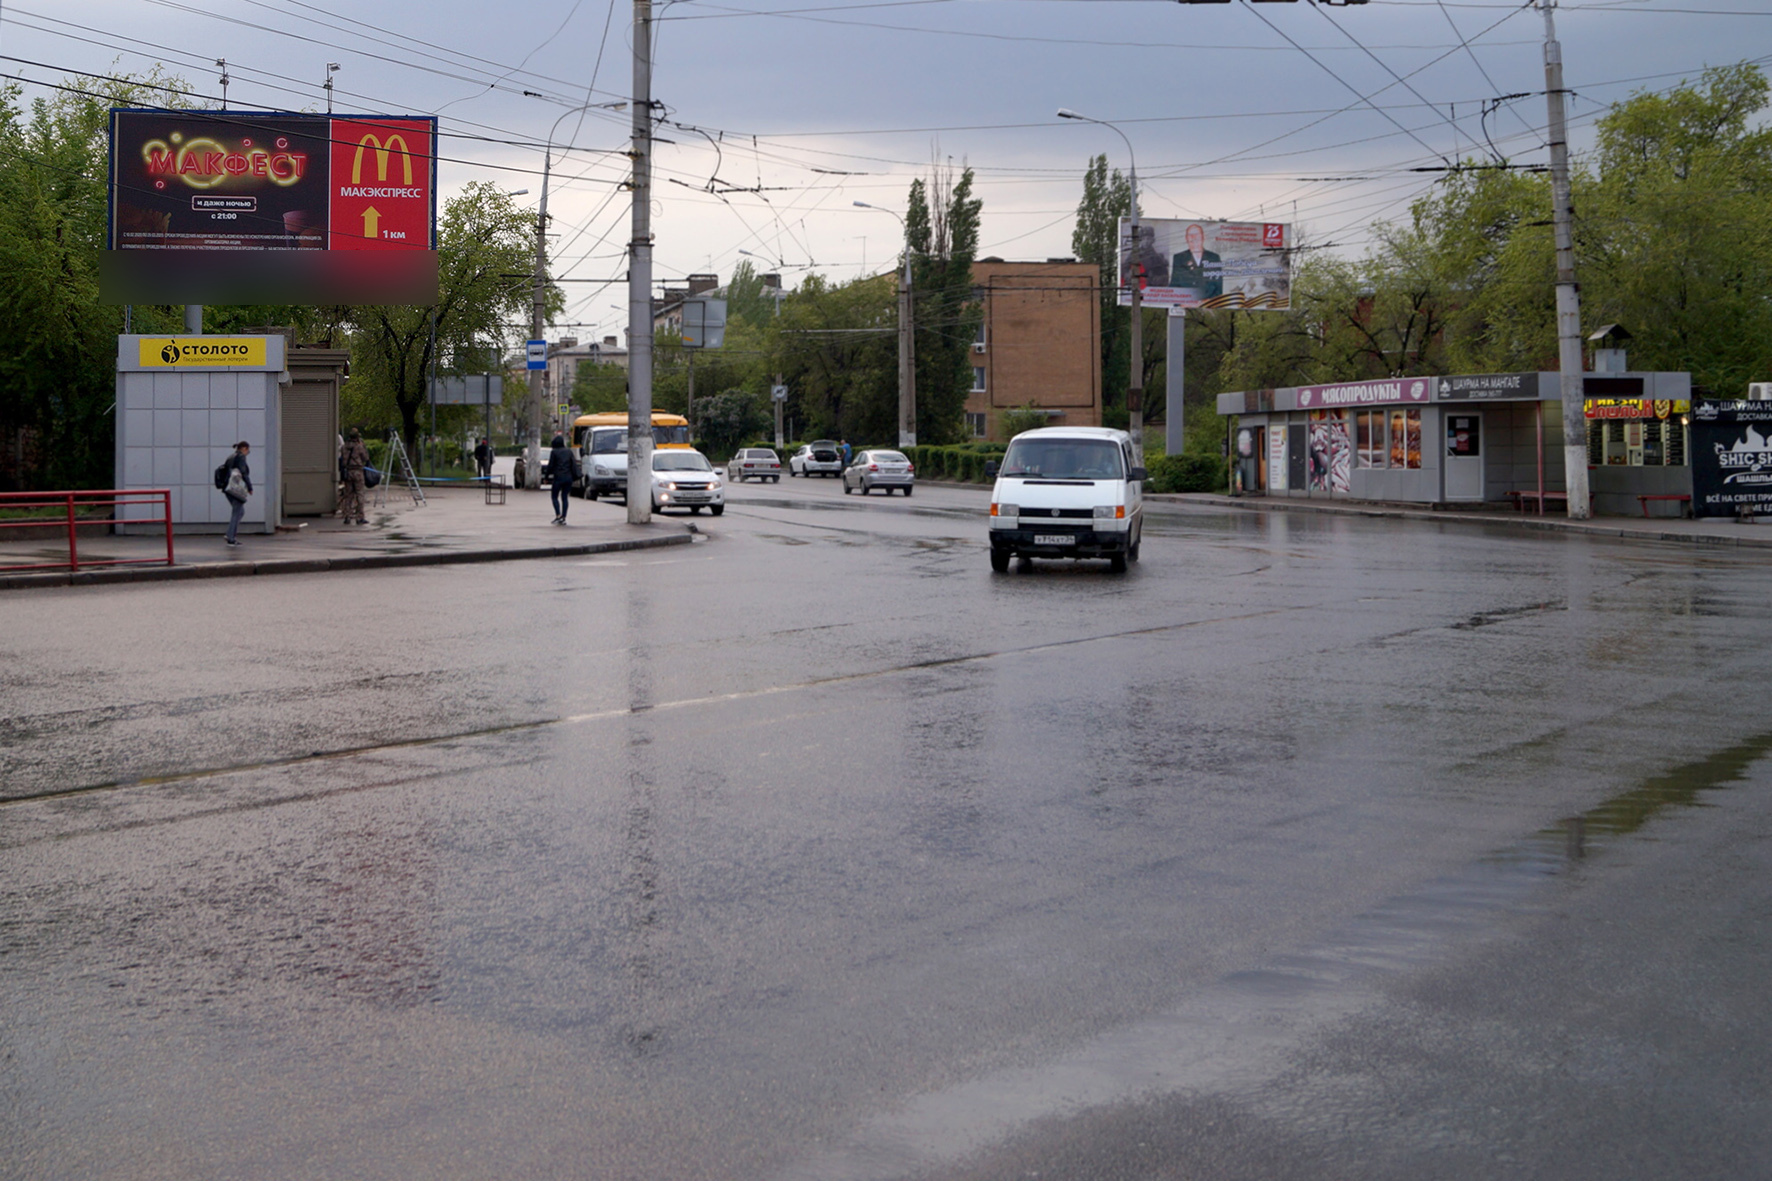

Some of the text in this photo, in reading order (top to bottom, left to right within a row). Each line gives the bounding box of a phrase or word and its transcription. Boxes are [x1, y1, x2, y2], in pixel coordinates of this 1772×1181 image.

[149, 151, 308, 177] МАКФЕСТ
[340, 186, 421, 198] МАКЭКСПРЕСС
[217, 212, 238, 220] 21:00
[382, 229, 389, 239] 1
[182, 345, 249, 355] СТОЛОТО
[1453, 376, 1521, 391] ШАУРМА НА МАНГАЛЕ
[1321, 382, 1401, 404] МЯСОПРОДУКТЫ
[1720, 401, 1763, 411] ШАУРМА
[1719, 453, 1755, 466] SHIC
[1705, 493, 1721, 503] ВСЁ
[1734, 494, 1757, 502] СВЕТЕ
